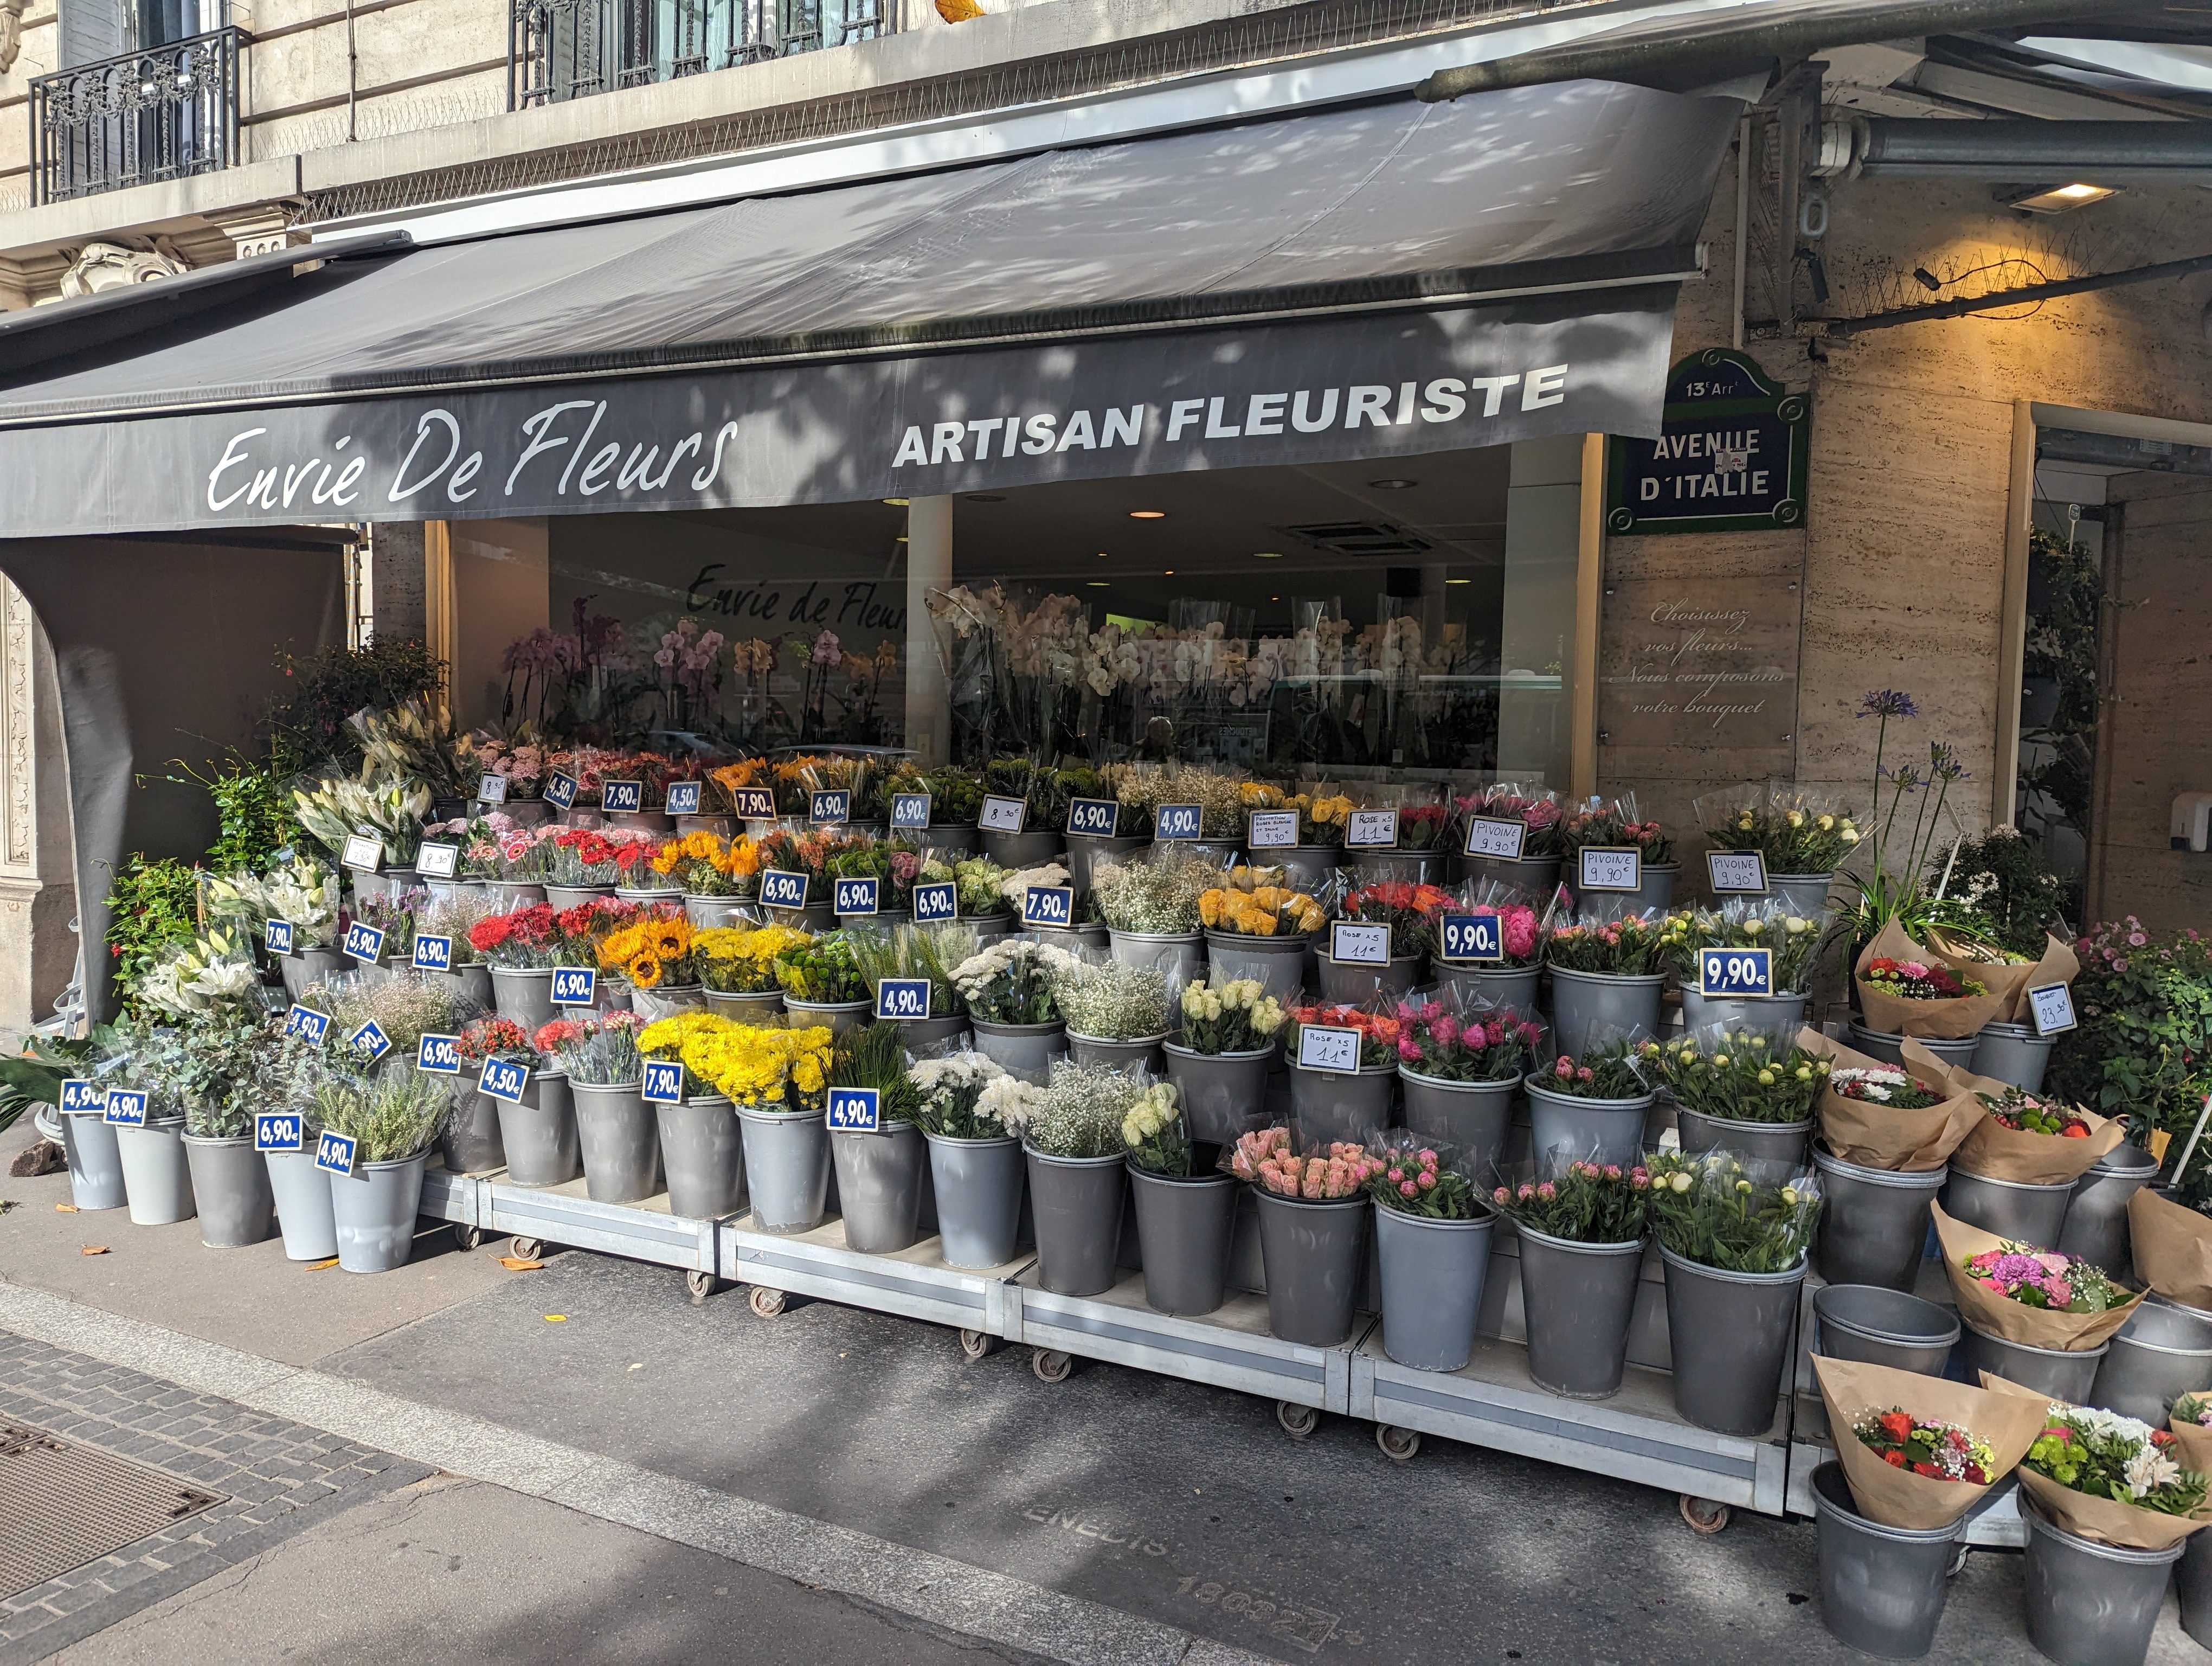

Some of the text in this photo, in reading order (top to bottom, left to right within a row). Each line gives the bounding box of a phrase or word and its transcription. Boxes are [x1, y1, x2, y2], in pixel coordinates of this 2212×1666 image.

[891, 364, 1568, 467] ARTISAN FLEURISTE
[207, 400, 737, 512] Envie De Fleurs
[1653, 430, 1760, 459] AVENUE
[686, 563, 780, 620] Envie
[789, 582, 830, 624] de
[1650, 597, 1750, 635] Choisissez
[1644, 642, 1676, 652] vos
[1609, 663, 1784, 698] Nous composons
[1632, 689, 1766, 728] votre bouquet
[549, 777, 571, 802] 4,50€
[607, 786, 636, 806] 7,90€
[671, 788, 696, 809] 4,50€
[739, 793, 772, 813] 7,90€
[815, 796, 845, 818] 6,90€
[896, 800, 925, 822] 6,90€
[1075, 805, 1111, 829] 6,90€
[1161, 810, 1198, 834] 4,90€
[1359, 814, 1378, 824] ROSE
[766, 877, 801, 900] 6,90€
[840, 885, 874, 908] 6,90€
[919, 890, 952, 916] 6,90€
[1028, 894, 1066, 918] 7,90€
[269, 927, 290, 947] 7,90€
[349, 927, 377, 955] 3,90€
[1447, 925, 1496, 953] 9,90€
[418, 941, 447, 962] 6,90€
[1708, 958, 1766, 988] 9,90€
[557, 975, 590, 997] 6,90€
[885, 990, 923, 1015] 4,90€
[424, 1041, 458, 1065] 6,90€
[484, 1066, 520, 1094] 4,50€
[647, 1069, 678, 1094] 7,90€
[110, 1096, 142, 1119] 6,90€
[835, 1100, 873, 1127] 4,90€
[261, 1120, 298, 1144] 6,90€
[320, 1140, 350, 1166] 4,90€
